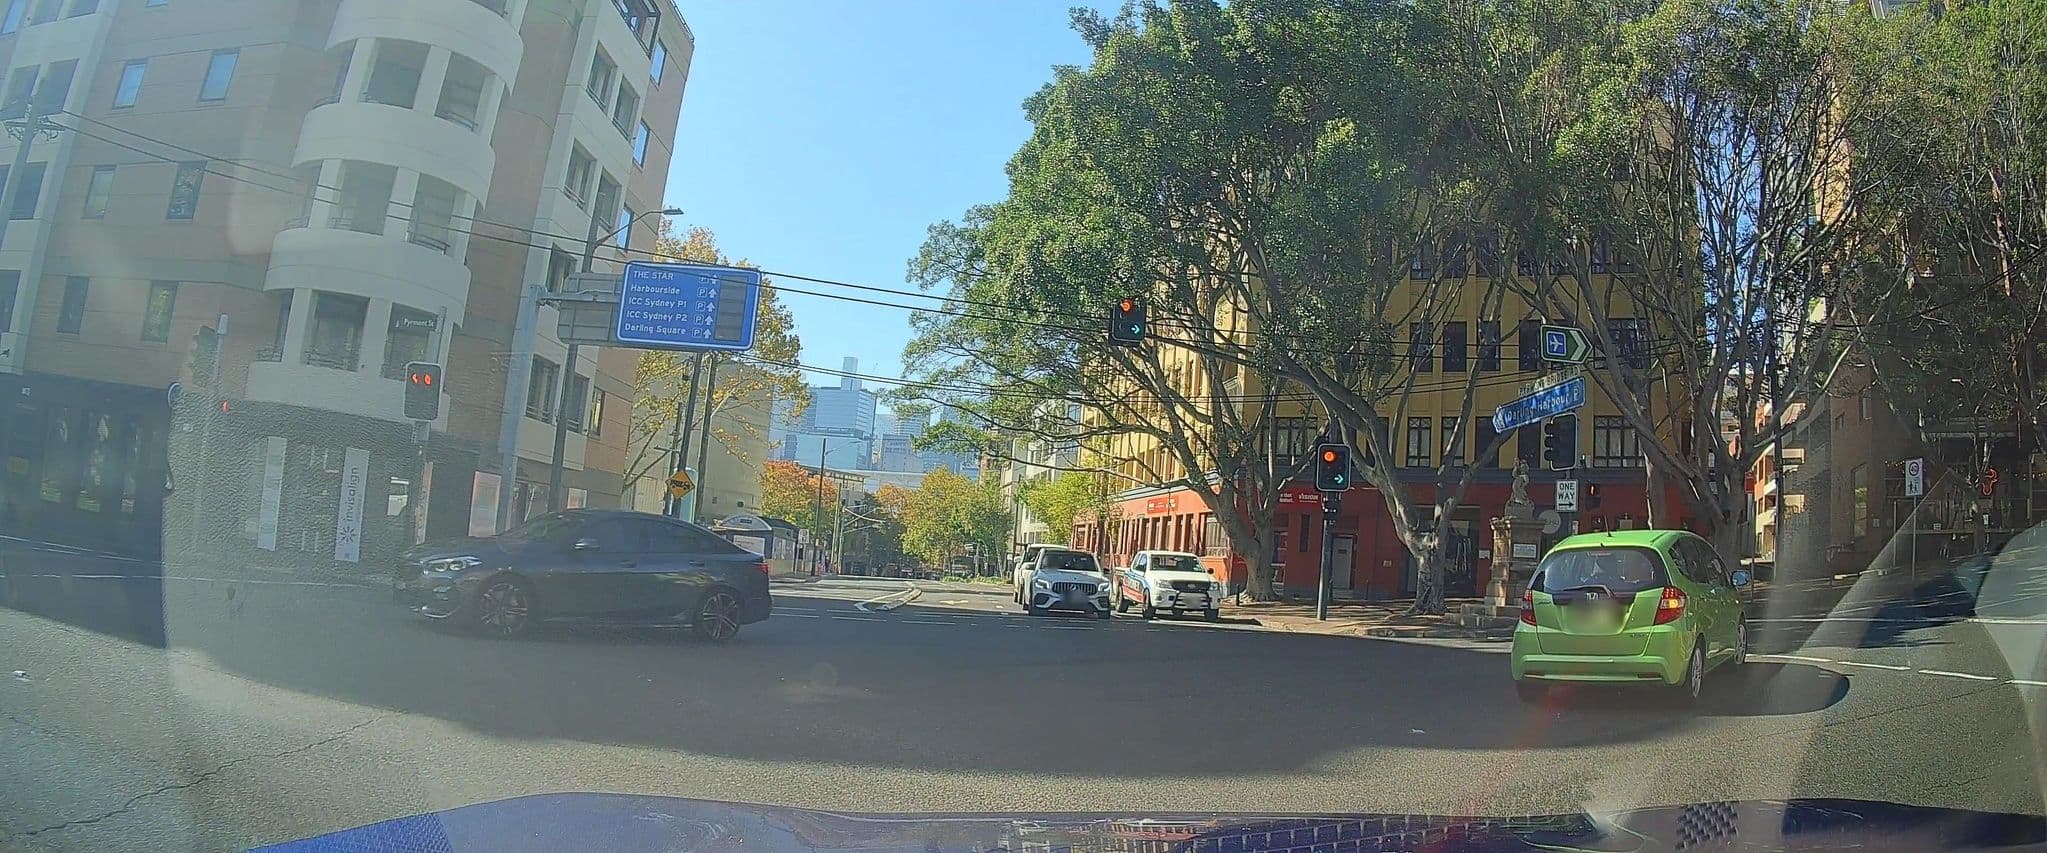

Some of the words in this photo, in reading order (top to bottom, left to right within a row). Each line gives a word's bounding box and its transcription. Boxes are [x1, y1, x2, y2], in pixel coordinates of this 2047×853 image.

[633, 270, 649, 280] THE
[651, 271, 674, 281] STAR
[630, 284, 681, 295] Harbourside
[628, 297, 642, 305] ICC
[645, 299, 675, 309] Sydney
[626, 310, 640, 319] ICC
[643, 311, 673, 322] Sydney
[675, 314, 688, 322] P2
[624, 323, 654, 334] Darling
[656, 325, 687, 336] Square
[1507, 406, 1534, 422] Darling
[1537, 392, 1570, 411] Harbour
[1559, 482, 1575, 490] ONE
[344, 466, 360, 522] invisalign
[1558, 492, 1575, 500] WAY
